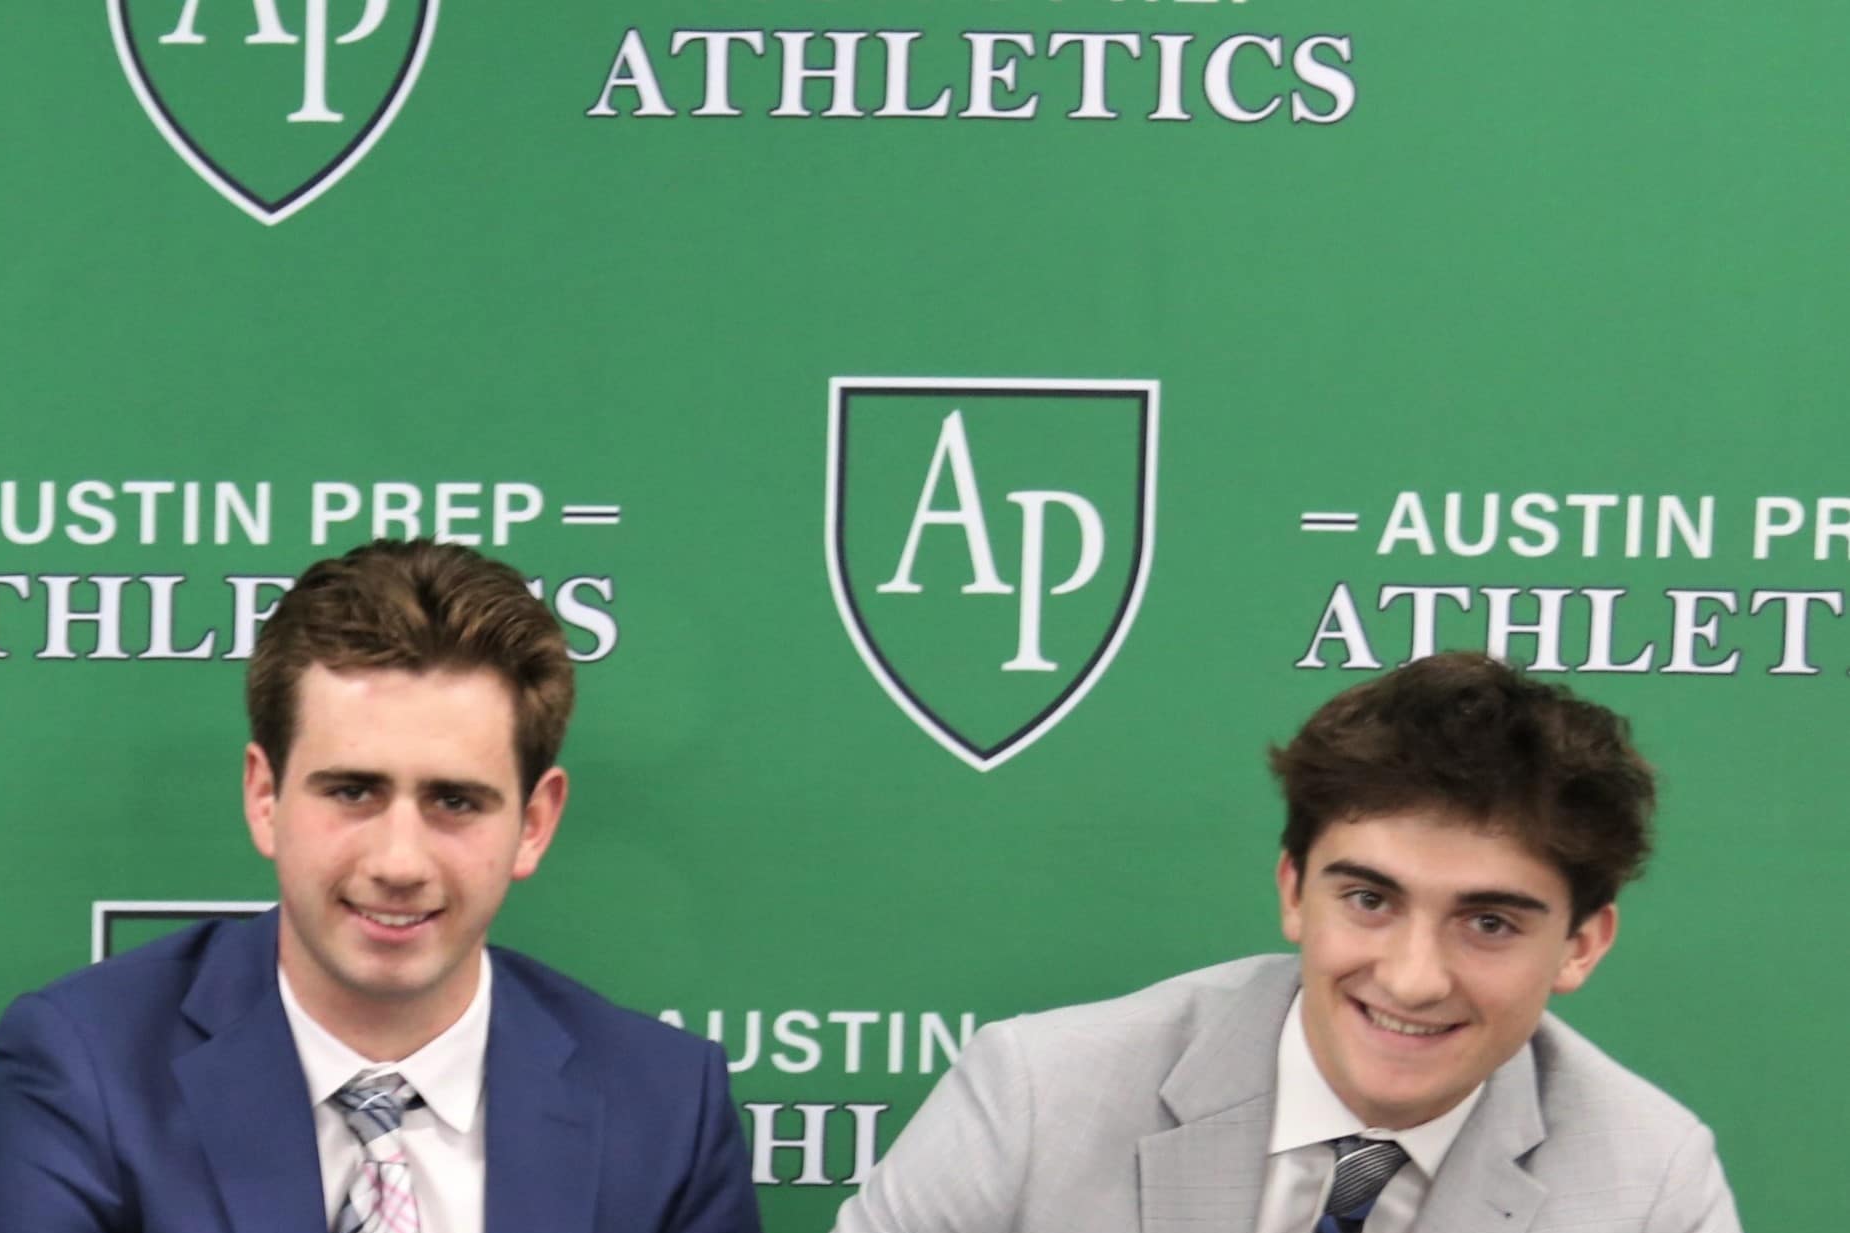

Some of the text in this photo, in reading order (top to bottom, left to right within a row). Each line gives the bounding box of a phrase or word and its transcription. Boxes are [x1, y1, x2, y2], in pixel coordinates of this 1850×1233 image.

[586, 29, 1357, 124] ATHLETICS
[310, 481, 545, 547] PREP
[876, 409, 1106, 672] AP
[1376, 491, 1715, 560] AUSTIN
[1294, 582, 1850, 675] ATHLET
